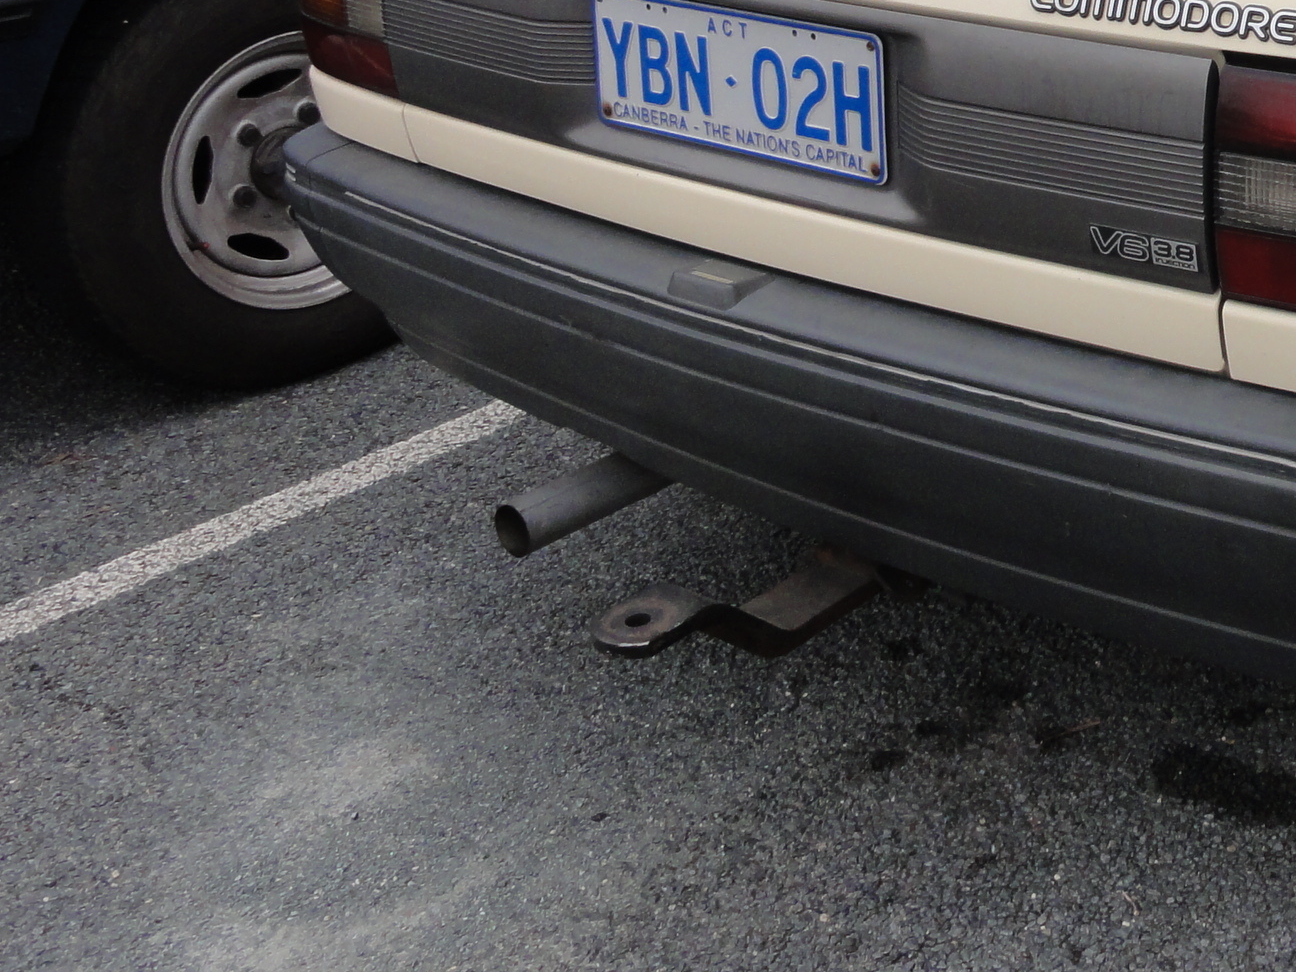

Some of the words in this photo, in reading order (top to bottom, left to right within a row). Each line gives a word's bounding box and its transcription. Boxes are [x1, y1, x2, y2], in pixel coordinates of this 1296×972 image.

[707, 17, 748, 39] ACT
[613, 101, 689, 131] CANBERRA
[703, 121, 731, 142] THE
[736, 129, 801, 159] NATION'S
[805, 145, 868, 173] CAPITAL
[1089, 226, 1150, 262] V6
[1153, 240, 1195, 263] 3.8
